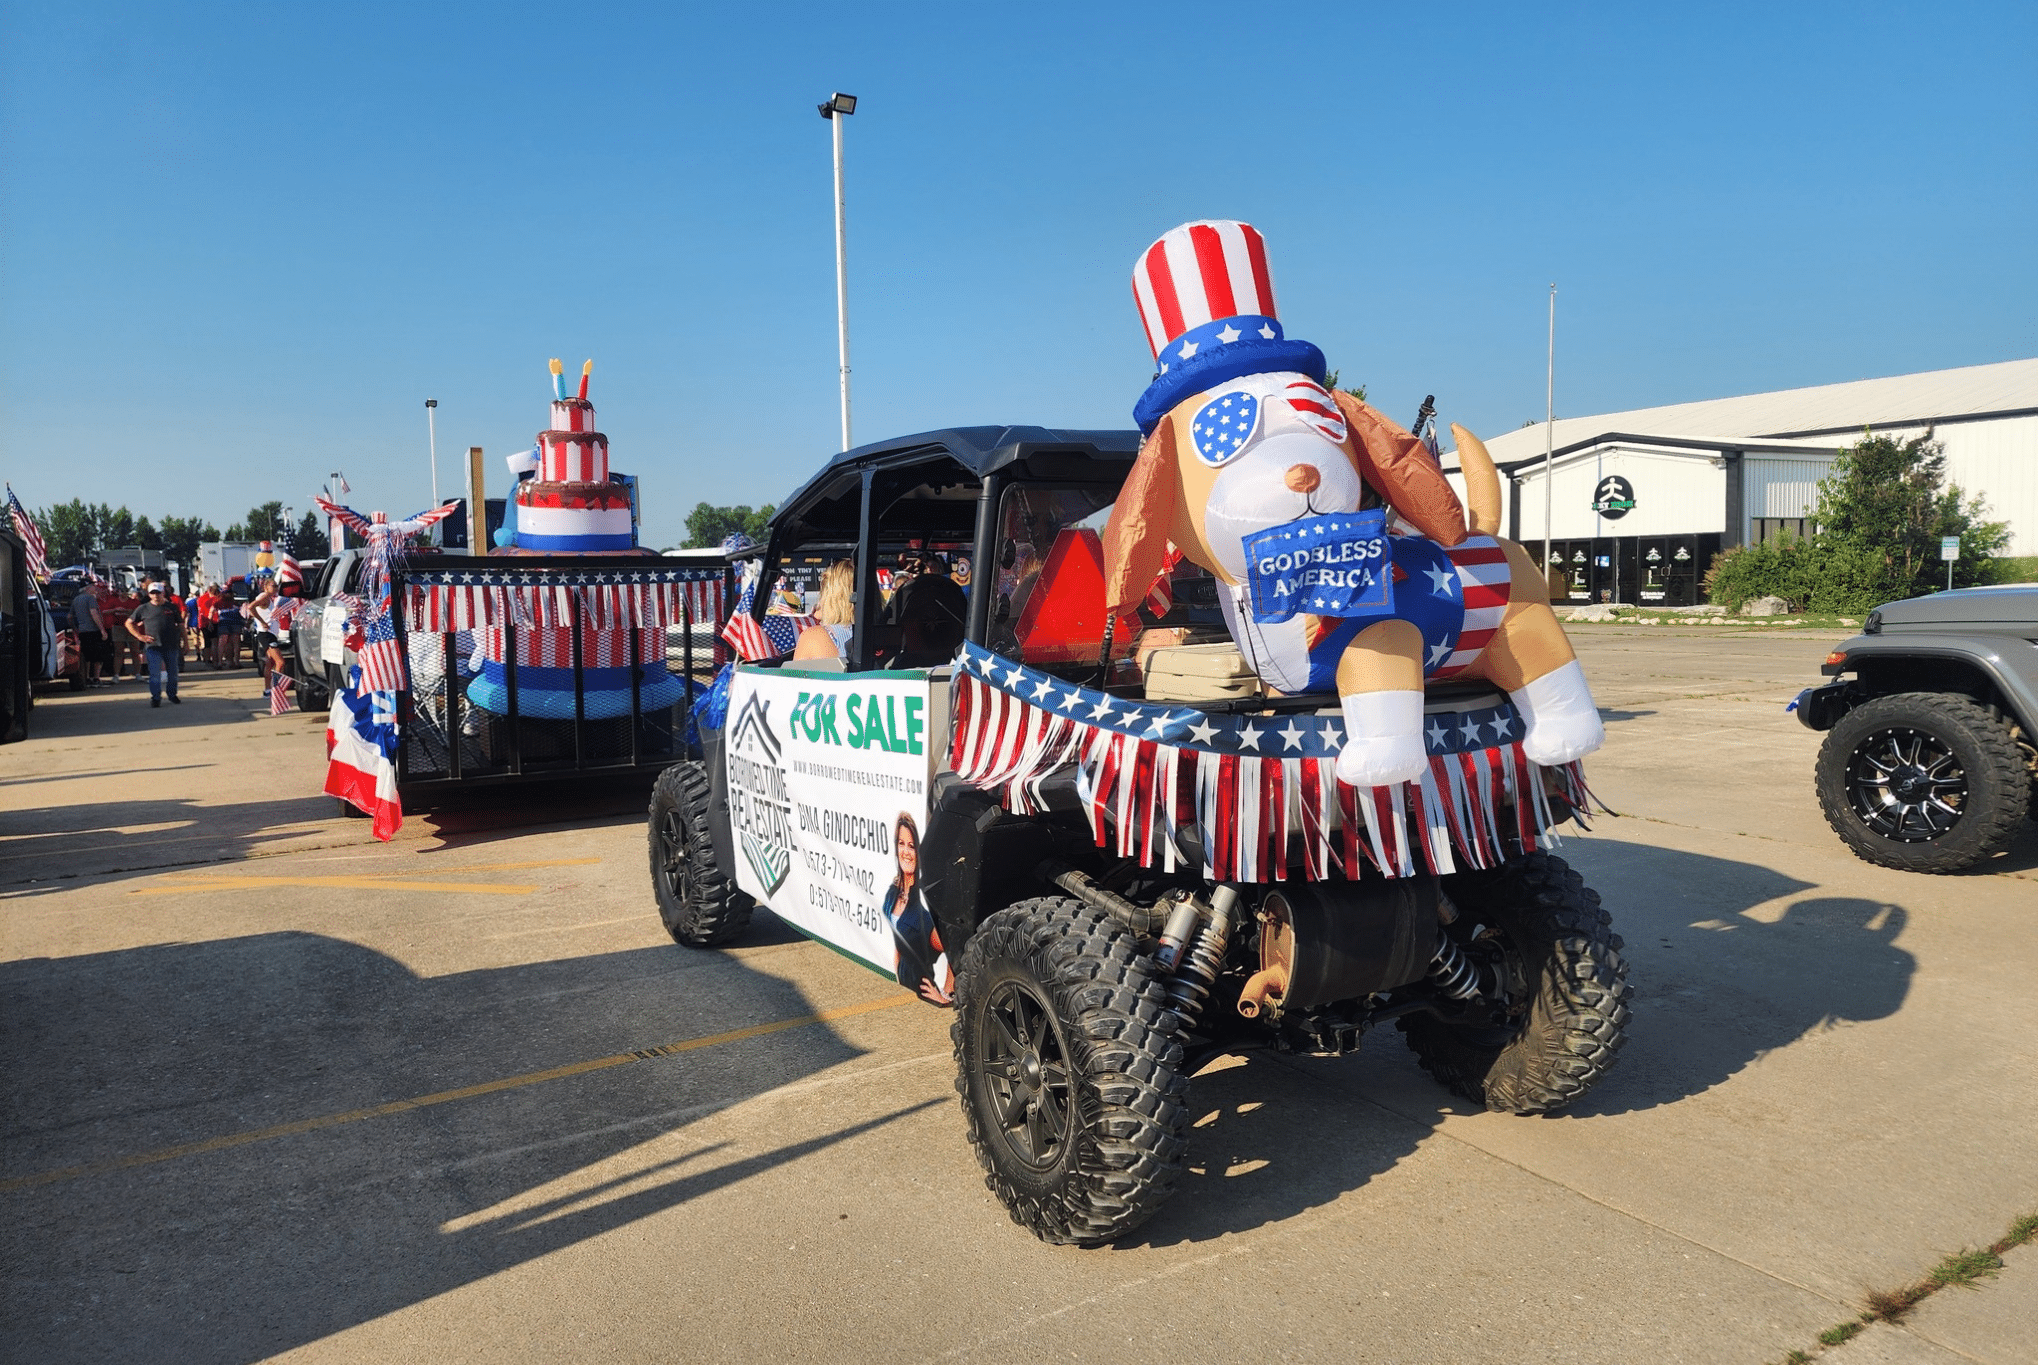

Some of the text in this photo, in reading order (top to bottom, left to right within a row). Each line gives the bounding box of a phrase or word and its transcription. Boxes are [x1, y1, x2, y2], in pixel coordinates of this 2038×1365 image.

[1259, 538, 1382, 575] GOD BLESS
[1273, 567, 1376, 597] AMERICA
[790, 692, 923, 755] FOR SALE
[729, 753, 790, 802] BOWED TIME
[793, 760, 922, 794] WWW.BORROWEDTIMEREALESTATE.COM
[753, 796, 798, 852] ESTATE
[823, 809, 889, 855] GINOCCHIO
